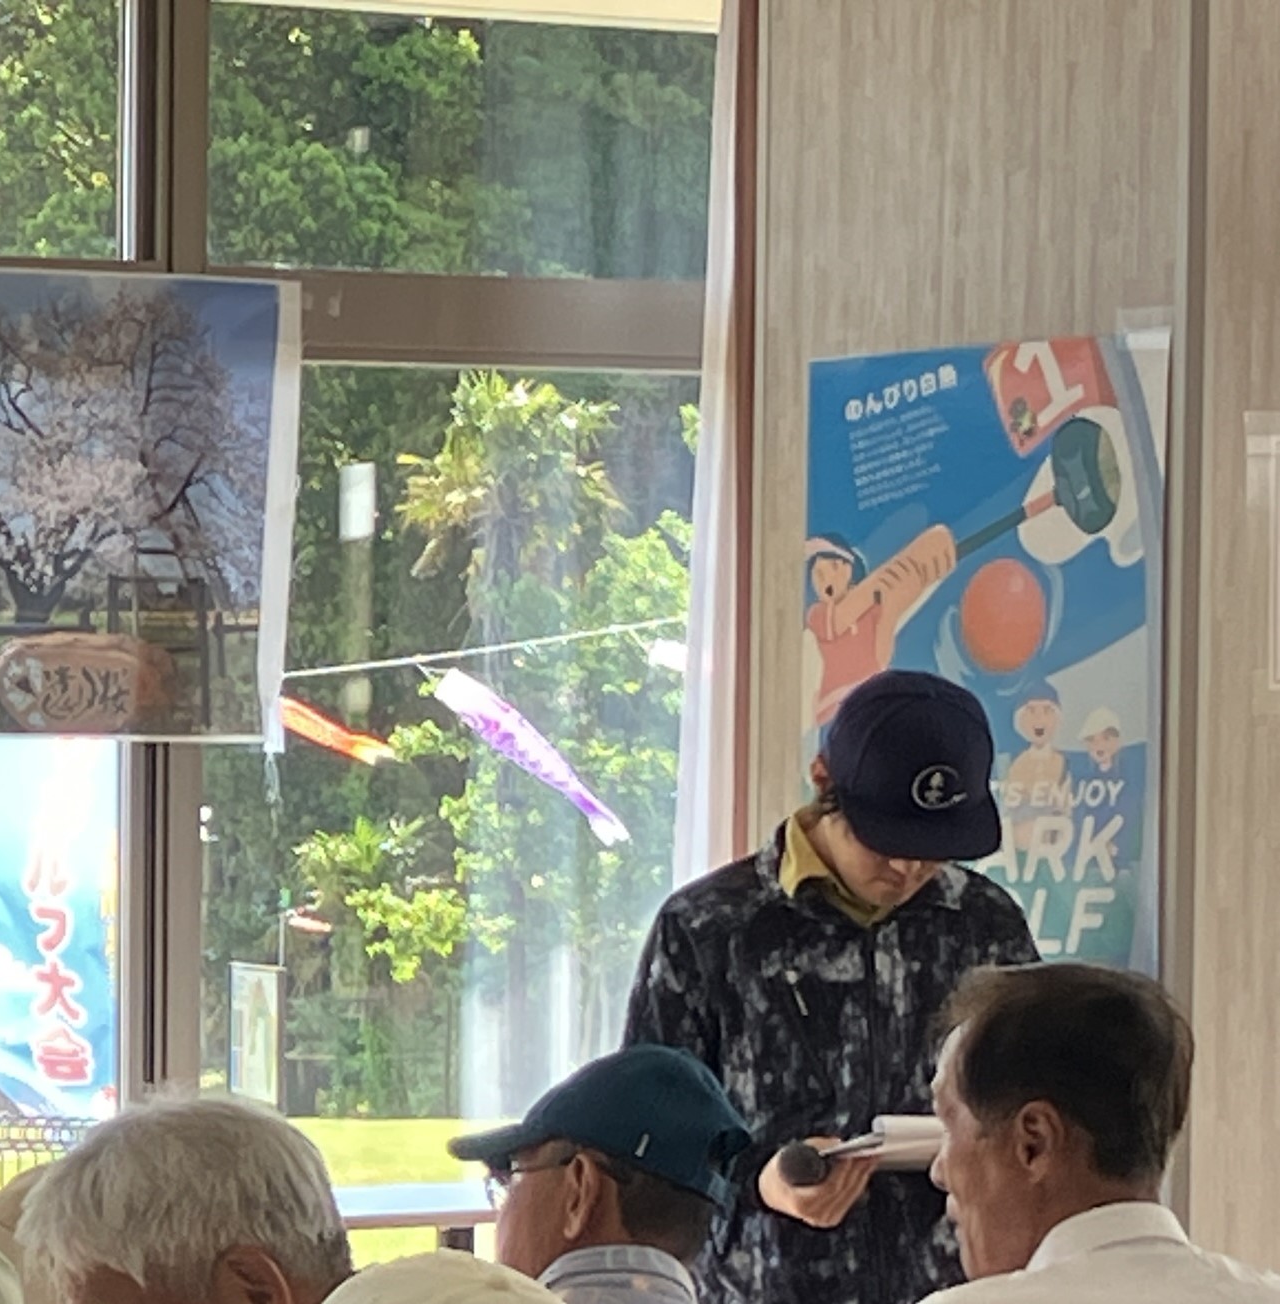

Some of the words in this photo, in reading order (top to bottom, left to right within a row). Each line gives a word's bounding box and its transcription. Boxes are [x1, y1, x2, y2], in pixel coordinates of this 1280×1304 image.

[1013, 340, 1084, 428] 1
[1028, 778, 1125, 808] ENJOY
[974, 814, 1124, 884] ARK
